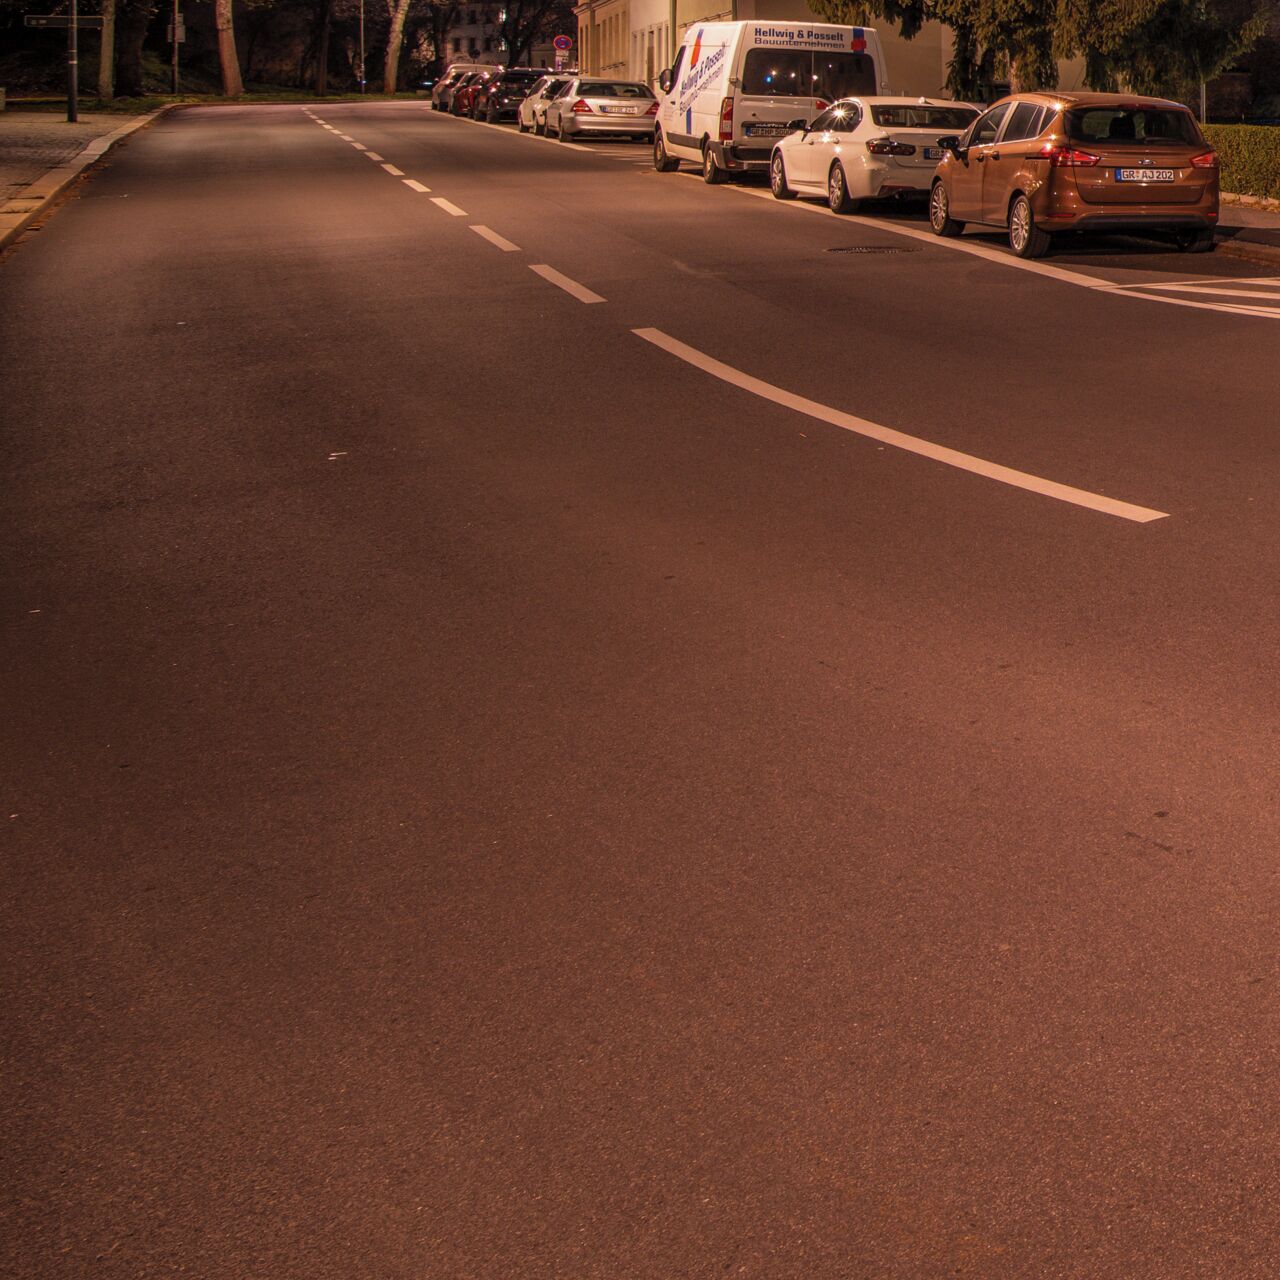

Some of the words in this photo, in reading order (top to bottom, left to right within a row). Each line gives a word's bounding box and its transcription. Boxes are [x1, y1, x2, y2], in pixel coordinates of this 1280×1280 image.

[754, 27, 794, 40] Hellwig
[797, 29, 804, 39] &
[807, 30, 844, 42] Posselt
[754, 37, 845, 49] Bauunternehmen
[1122, 170, 1135, 179] GR
[1141, 171, 1155, 180] AJ
[1155, 171, 1173, 180] 202
